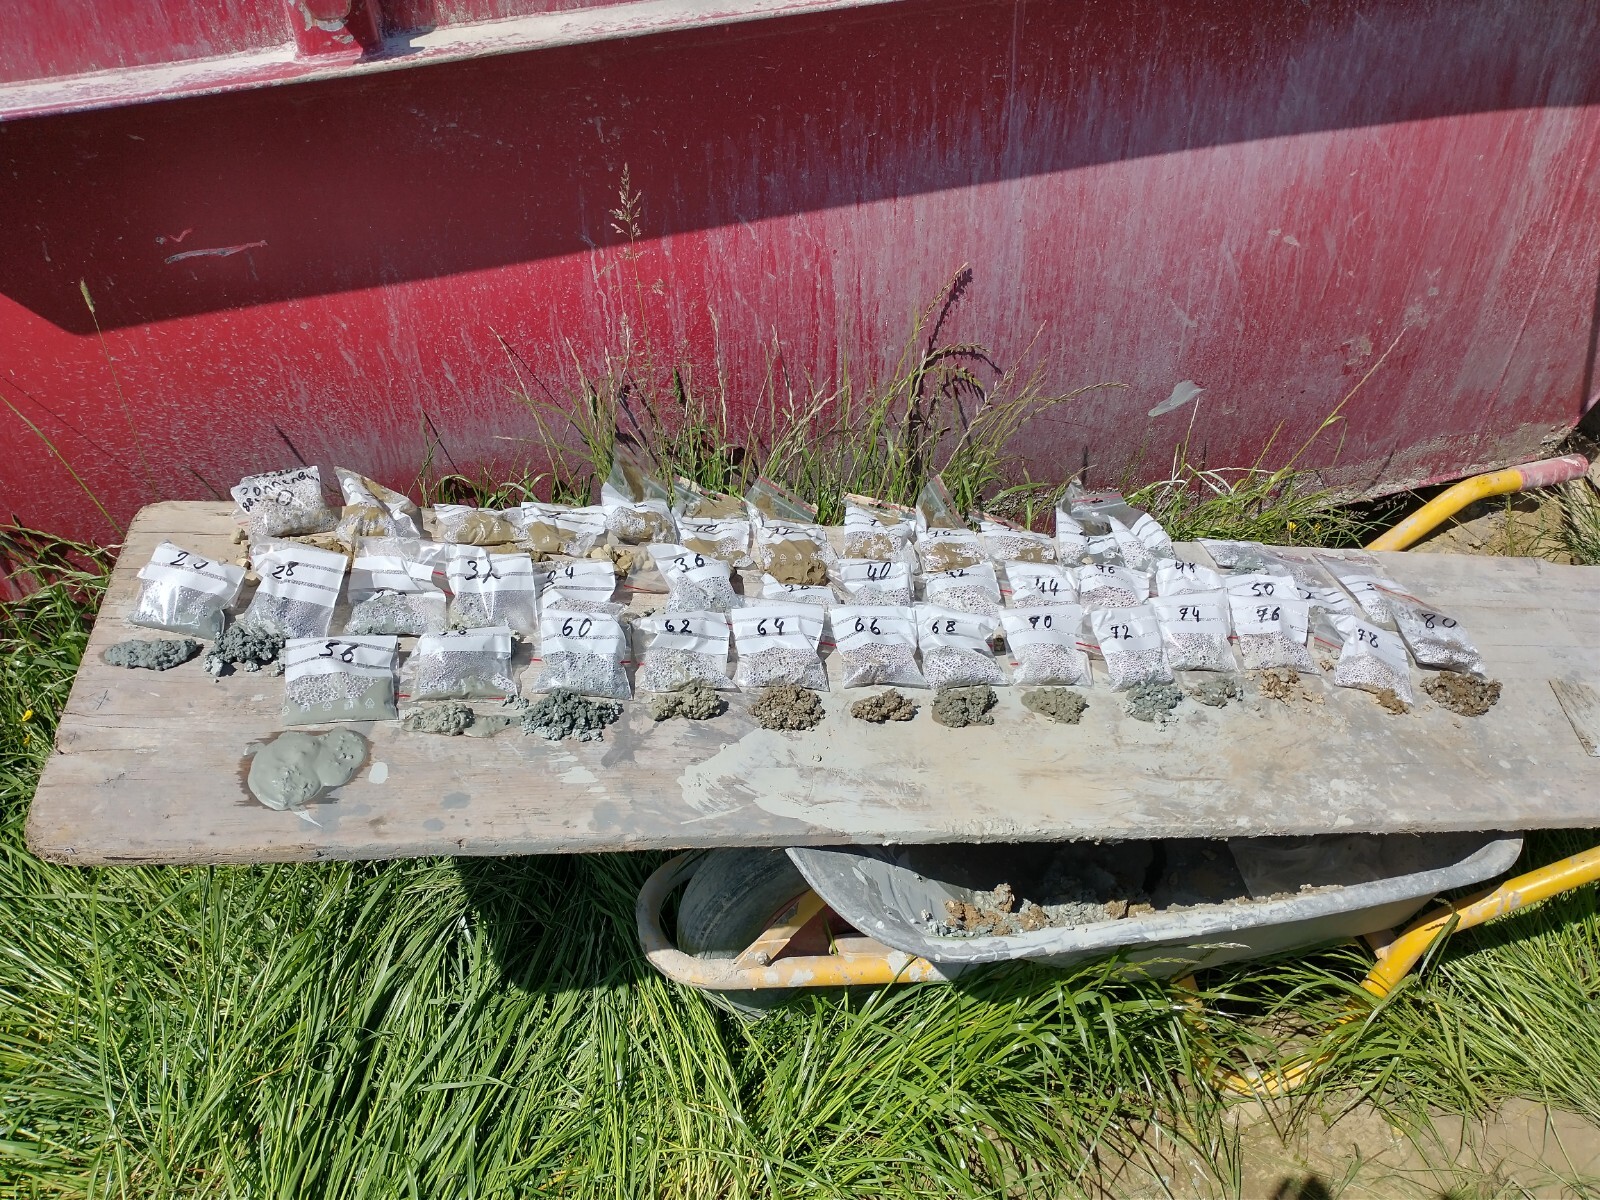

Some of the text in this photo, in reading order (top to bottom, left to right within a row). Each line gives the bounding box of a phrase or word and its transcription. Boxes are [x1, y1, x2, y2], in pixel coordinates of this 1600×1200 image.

[272, 561, 299, 579] 28
[674, 553, 706, 573] 36
[867, 561, 892, 582] 40
[1251, 583, 1275, 597] 50
[1028, 615, 1052, 630] 70
[1179, 606, 1200, 623] 74
[1256, 606, 1281, 624] 76
[1421, 613, 1458, 630] 80
[562, 617, 593, 638] 60
[664, 619, 693, 634] 62
[757, 618, 785, 637] 64
[854, 617, 881, 635] 66
[931, 620, 956, 635] 68
[1110, 624, 1134, 641] 72
[1357, 628, 1379, 648] 78
[319, 642, 355, 663] 56
